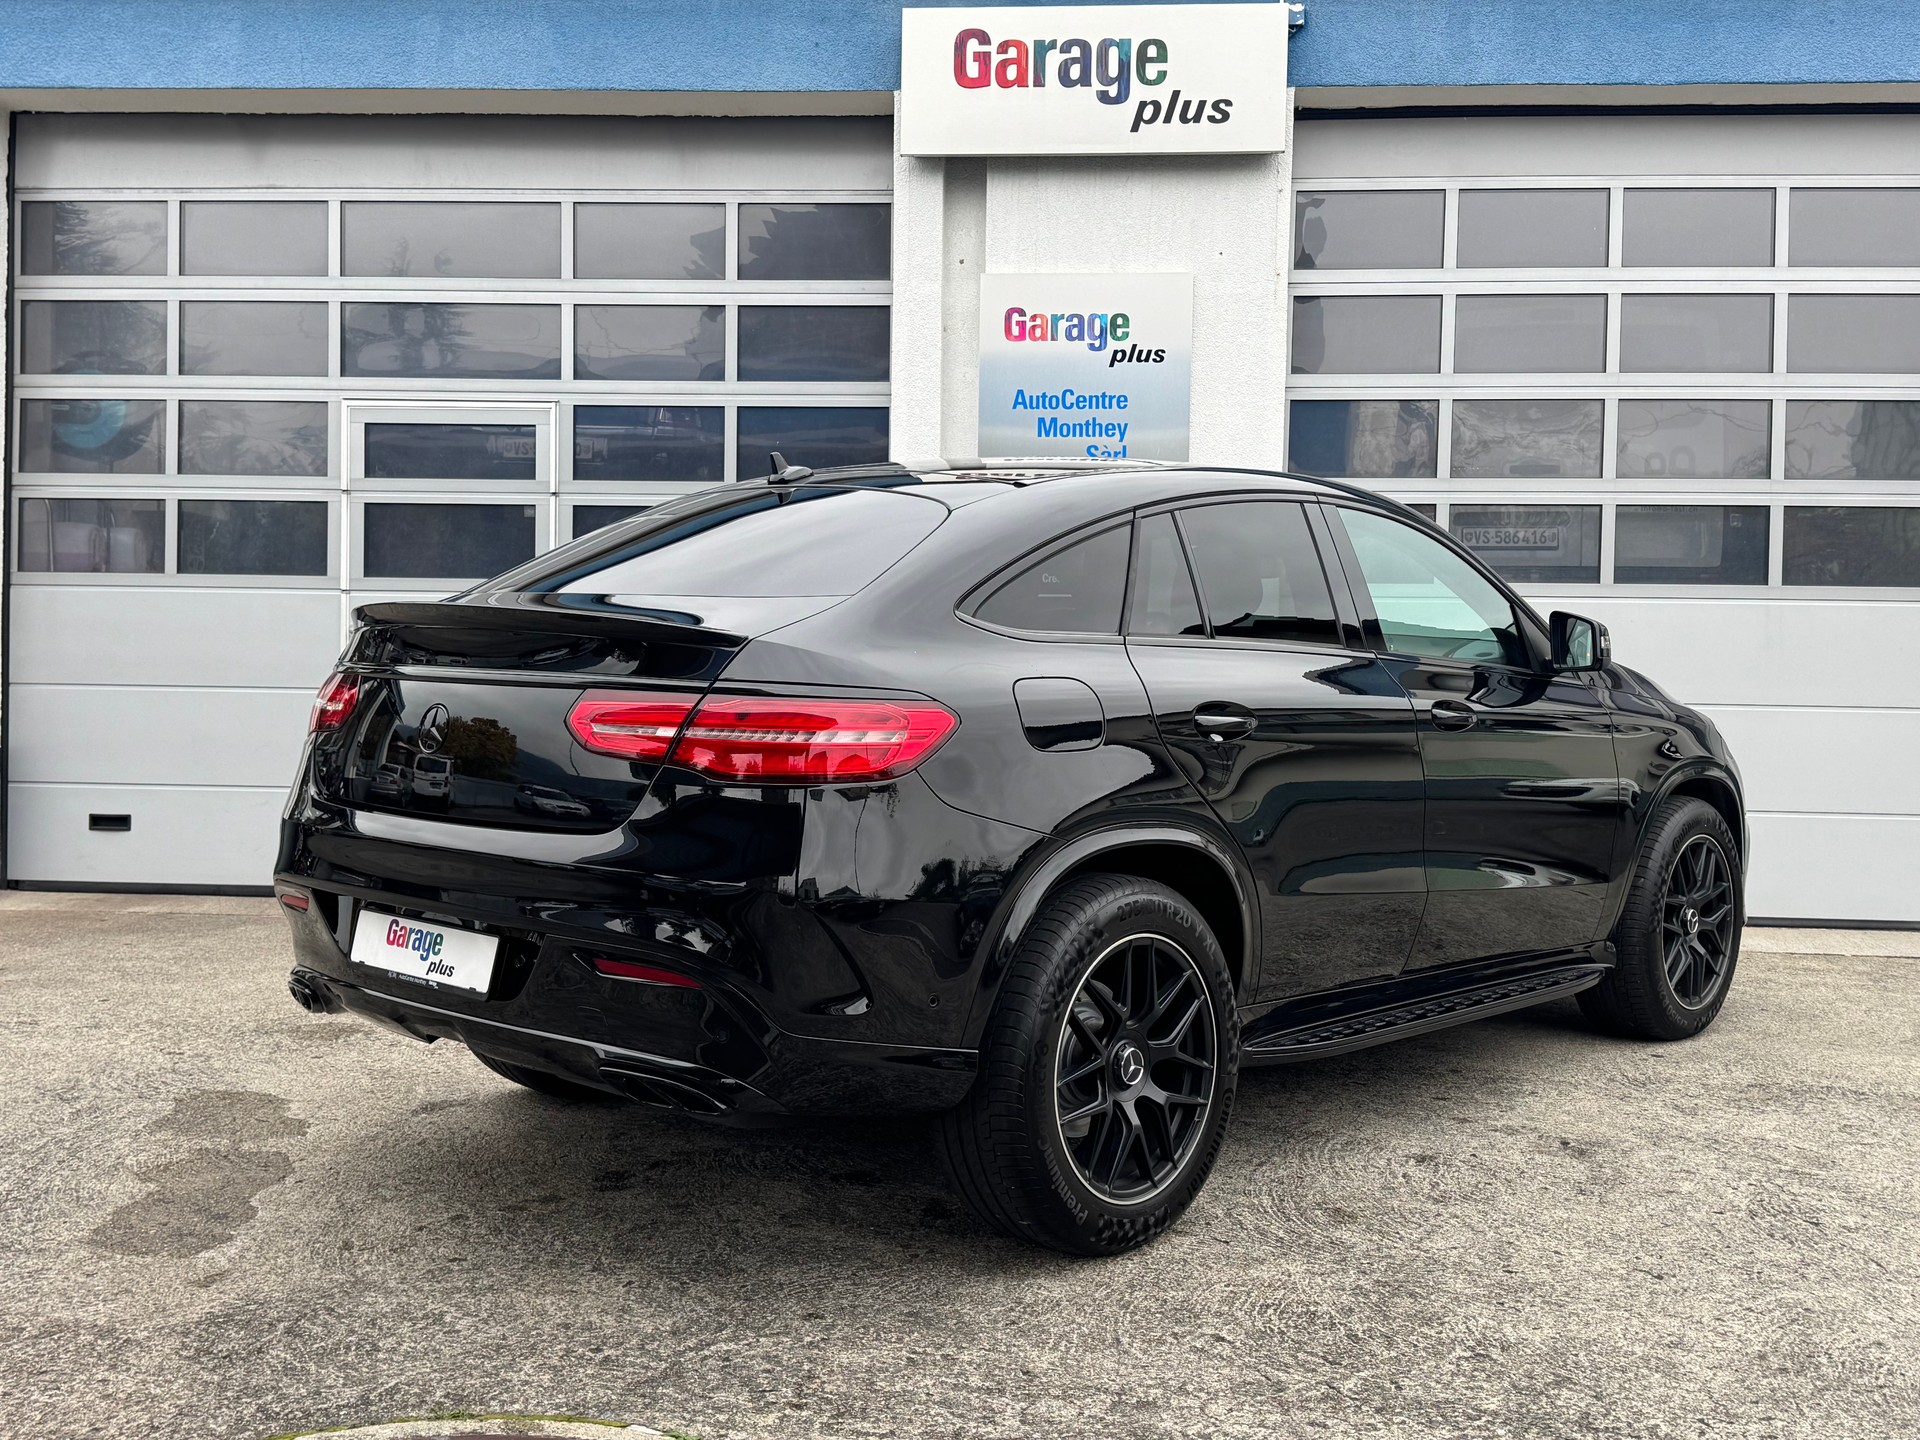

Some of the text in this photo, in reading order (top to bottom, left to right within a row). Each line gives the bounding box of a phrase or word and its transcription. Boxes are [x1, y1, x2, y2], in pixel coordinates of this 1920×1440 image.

[954, 28, 1168, 105] Garage
[1130, 90, 1233, 132] plus
[1004, 307, 1130, 351] Garage
[1108, 344, 1166, 367] plus
[1012, 389, 1128, 410] AutoCentre
[1037, 417, 1128, 442] Monthey
[386, 918, 444, 961] Garage
[426, 959, 455, 977] plus
